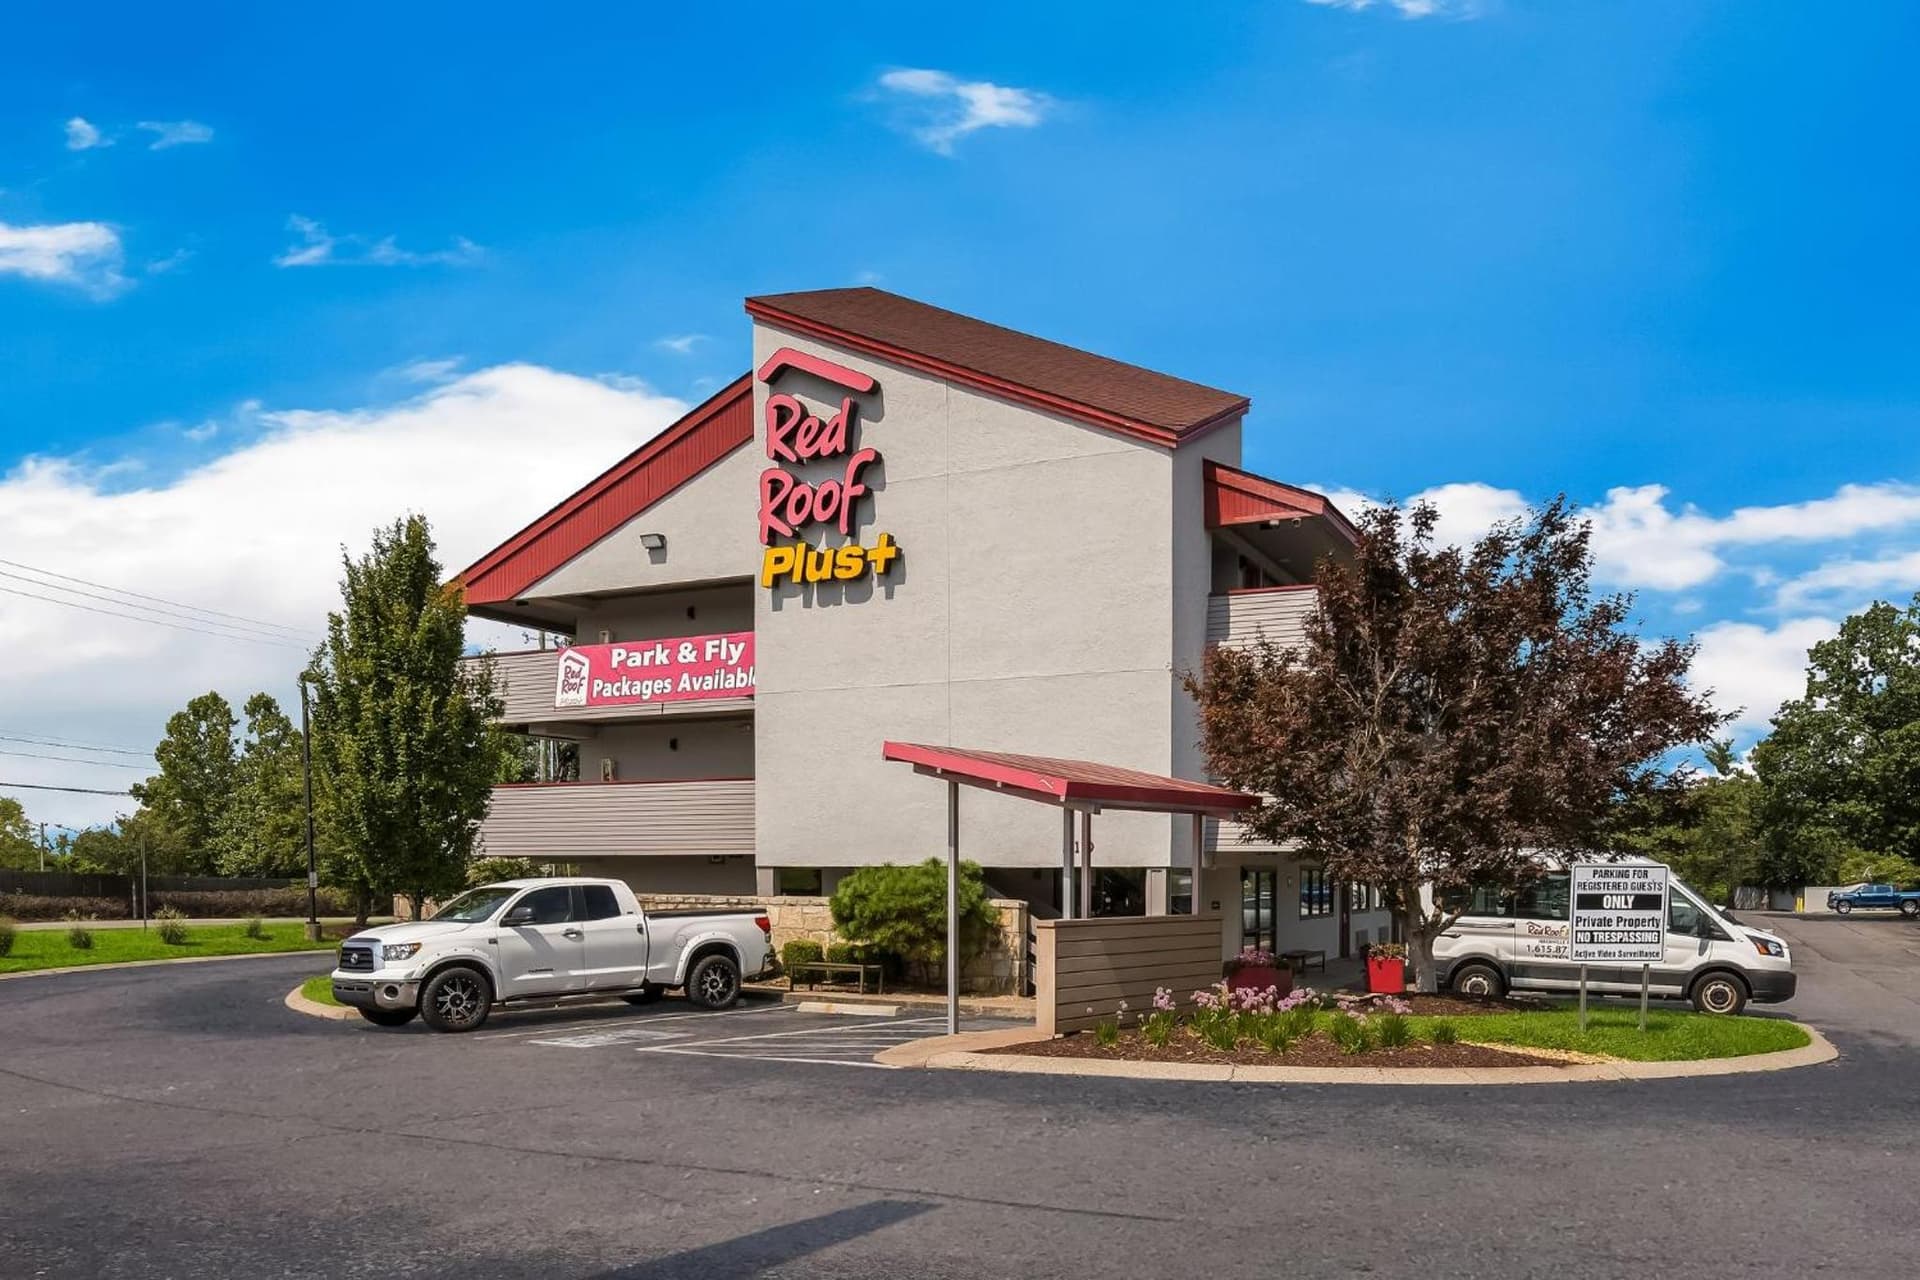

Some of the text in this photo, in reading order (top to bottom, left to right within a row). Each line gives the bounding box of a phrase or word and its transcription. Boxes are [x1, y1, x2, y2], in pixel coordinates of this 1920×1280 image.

[766, 394, 853, 463] Red
[758, 448, 877, 545] Roof
[761, 532, 897, 588] Plus+
[610, 637, 746, 669] Park & Fly
[564, 665, 583, 680] Red
[561, 676, 586, 695] Roof
[592, 665, 755, 700] Packages Availabl
[1593, 869, 1648, 879] PARKING FOR
[1577, 881, 1628, 891] REGISTERED
[1603, 895, 1635, 909] ONLY
[1575, 916, 1661, 928] Private Property
[1576, 931, 1591, 943] NO
[1593, 931, 1658, 943] TRESPASSING
[1527, 944, 1568, 954] 1.615.87
[1574, 950, 1596, 958] Active
[1617, 950, 1660, 958] Surveillance
